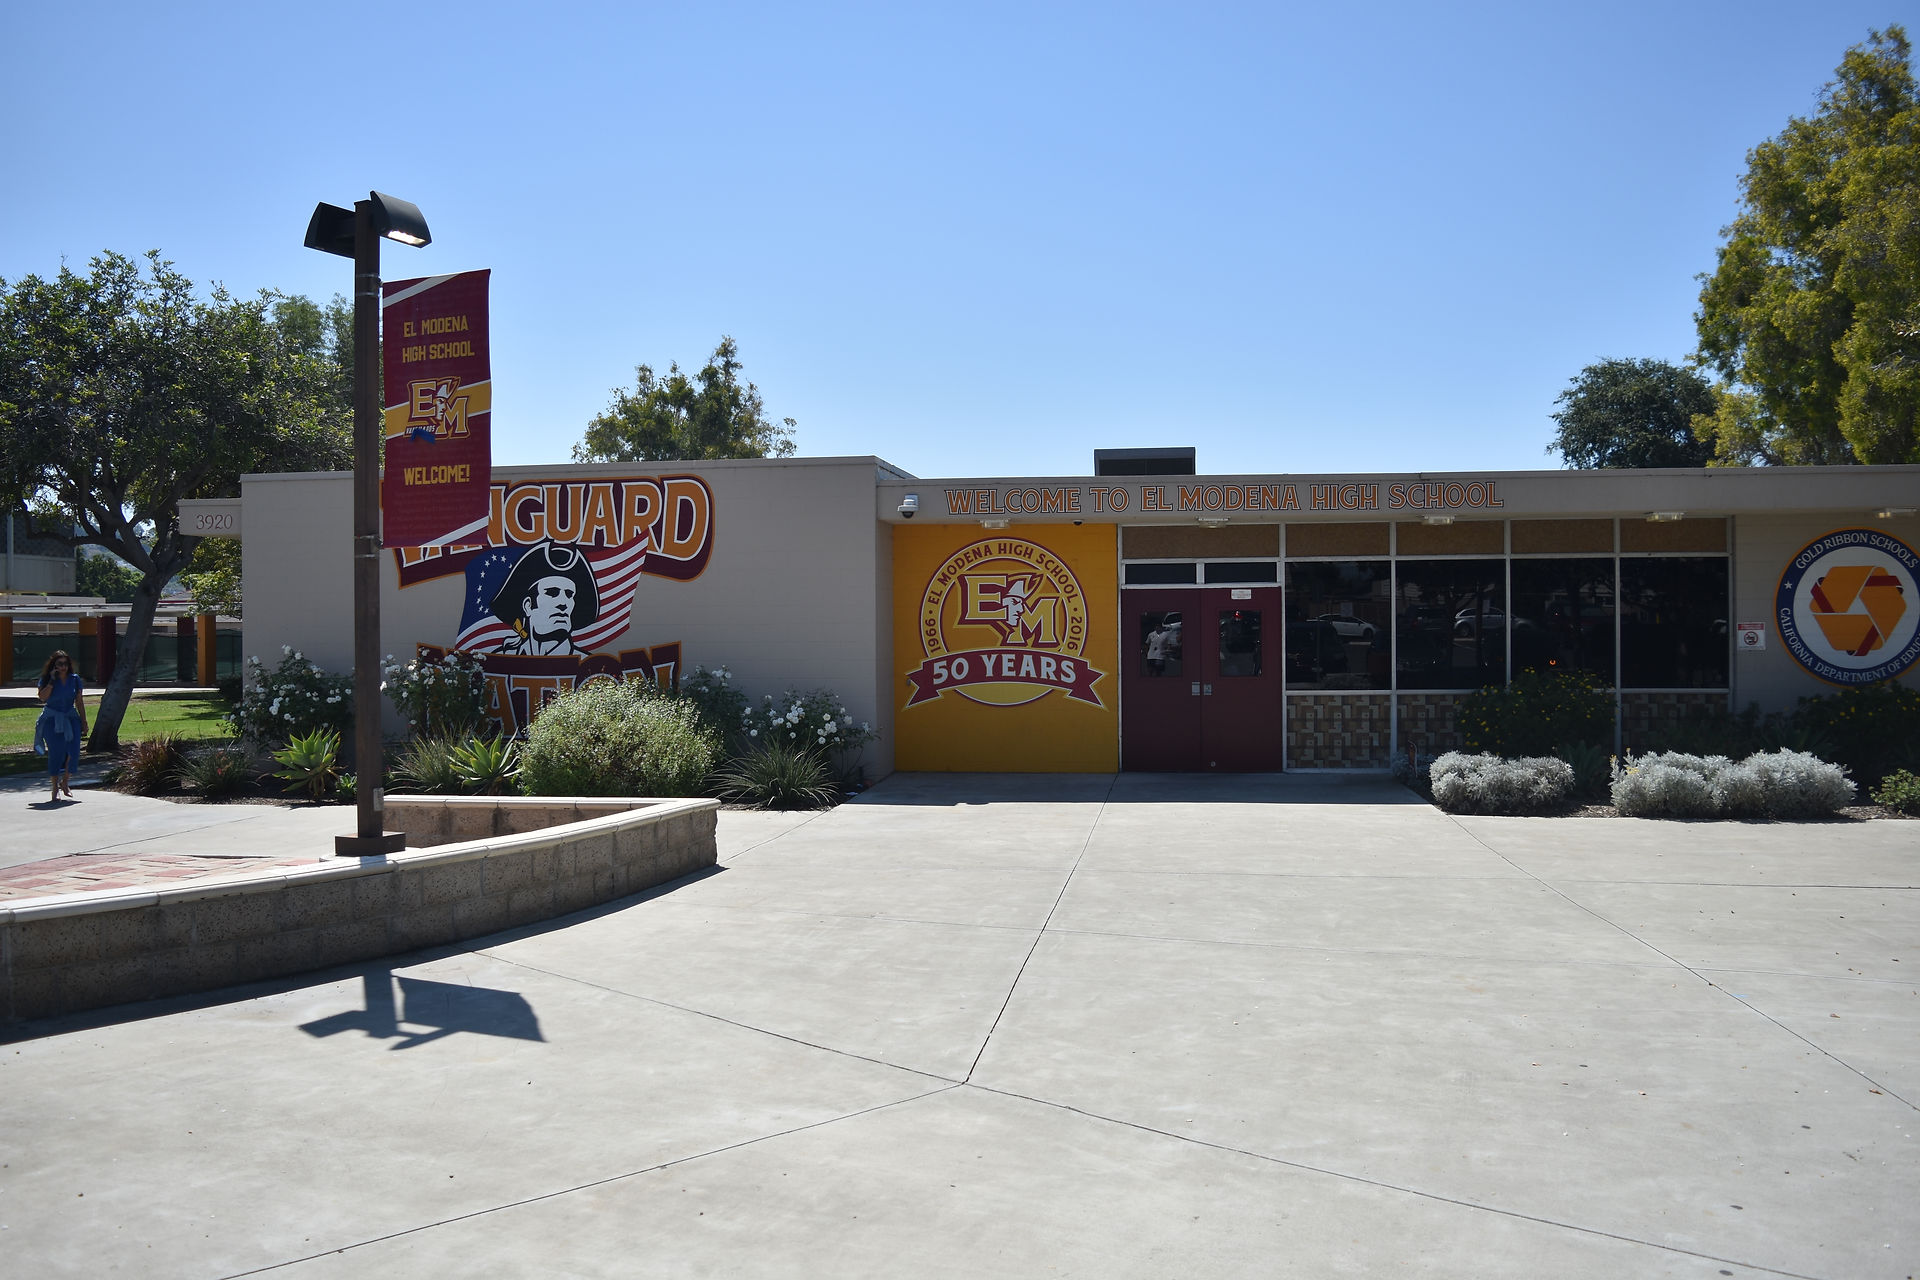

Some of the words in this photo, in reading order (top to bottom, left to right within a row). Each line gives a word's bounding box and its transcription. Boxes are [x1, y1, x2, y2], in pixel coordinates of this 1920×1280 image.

[403, 321, 417, 338] EL
[421, 315, 469, 336] MODENA
[402, 345, 427, 363] HIGH
[429, 340, 475, 360] SCHOOL
[404, 464, 471, 486] WELCOME!
[945, 487, 1081, 515] WELCOME
[1089, 486, 1130, 513] TO
[1140, 485, 1173, 512] EL
[1178, 484, 1301, 511] MODENA
[1309, 484, 1379, 511] HIGH
[1388, 481, 1504, 510] SCHOOL
[196, 513, 233, 530] 3920
[937, 544, 993, 588] MODENA
[997, 543, 1034, 559] HIGH
[1795, 543, 1824, 569] GOLD
[1823, 532, 1869, 550] RIBBON
[1869, 534, 1919, 569] SCHOOLS
[1035, 553, 1080, 604] SCHOOL
[928, 589, 942, 605] EL
[925, 618, 941, 652] 1966
[1067, 616, 1082, 650] 2016
[1780, 607, 1814, 667] CALIFORNIA
[1814, 661, 1888, 683] DEPARTMENT
[1888, 661, 1901, 672] OF
[1902, 632, 1920, 665] EDUC
[932, 657, 970, 685] 50
[980, 653, 1077, 684] YEARS
